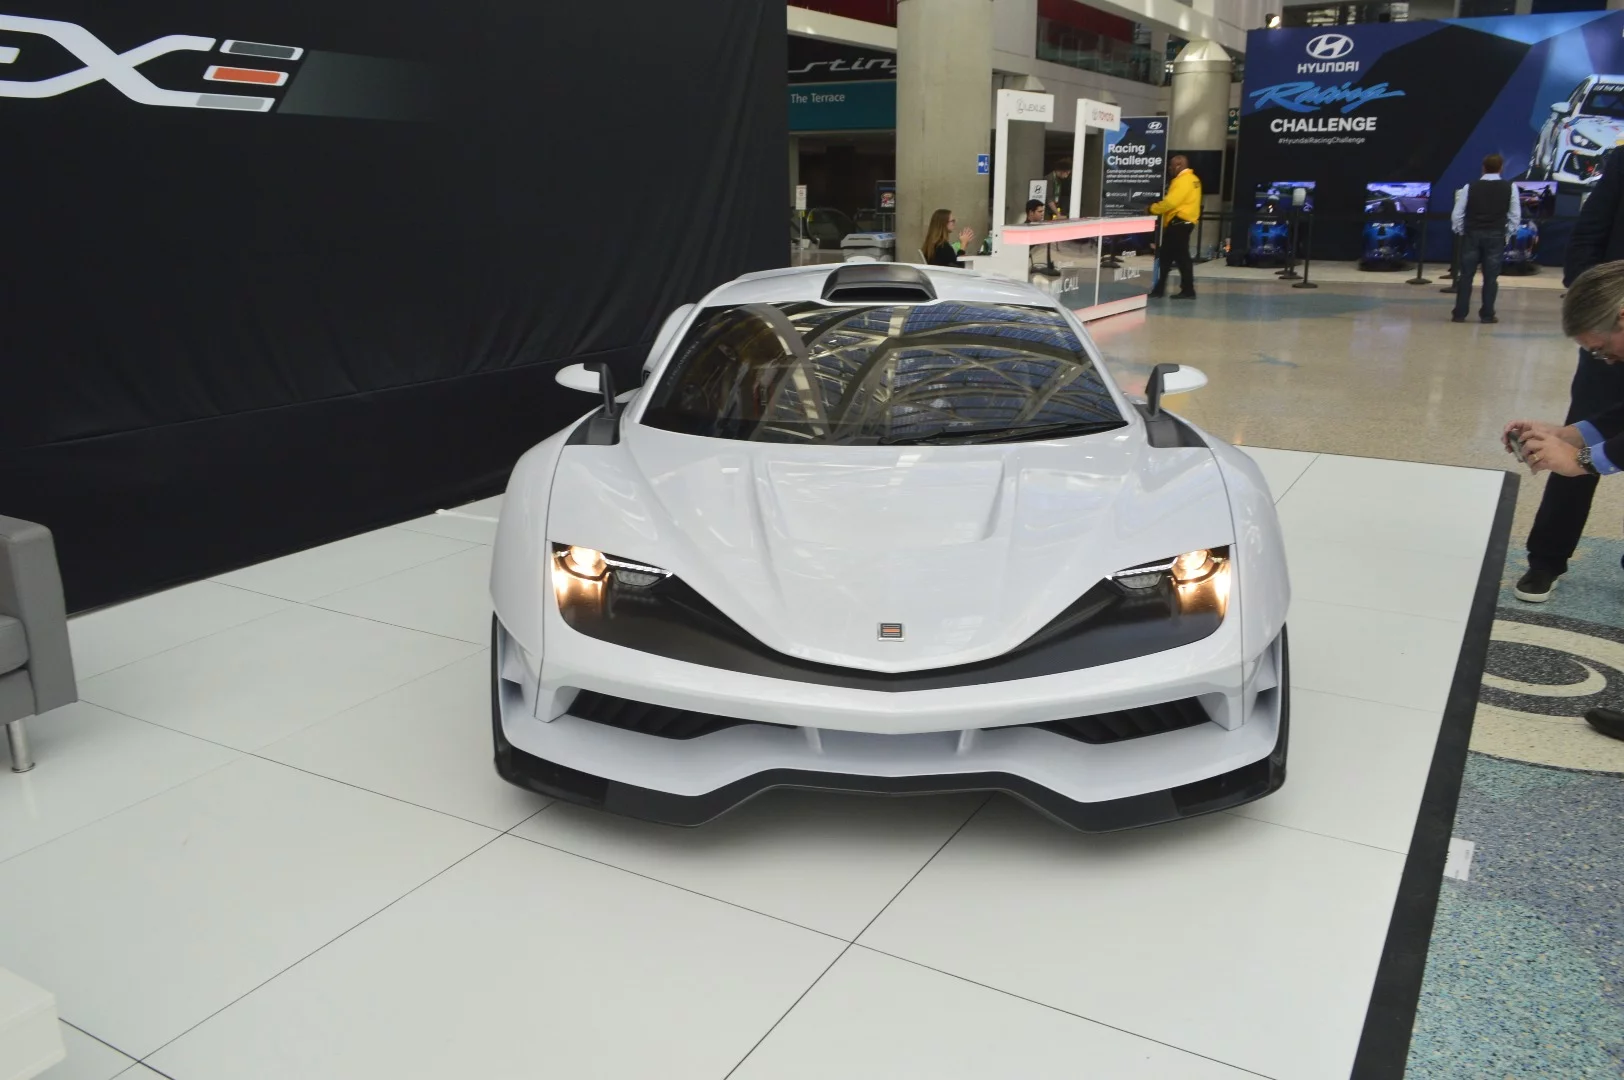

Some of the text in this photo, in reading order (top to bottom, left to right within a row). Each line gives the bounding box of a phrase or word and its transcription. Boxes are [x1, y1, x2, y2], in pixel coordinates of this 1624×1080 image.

[788, 57, 896, 74] stin
[1297, 61, 1360, 74] HYUNDAI
[791, 92, 845, 103] The Terrace
[1249, 81, 1406, 114] Racing
[1270, 116, 1377, 133] CHALLENGE
[1278, 136, 1366, 145] #HyundaiRacingChallenge
[1107, 142, 1146, 155] Racing
[1107, 155, 1162, 167] Challenge
[1064, 276, 1080, 292] CALL
